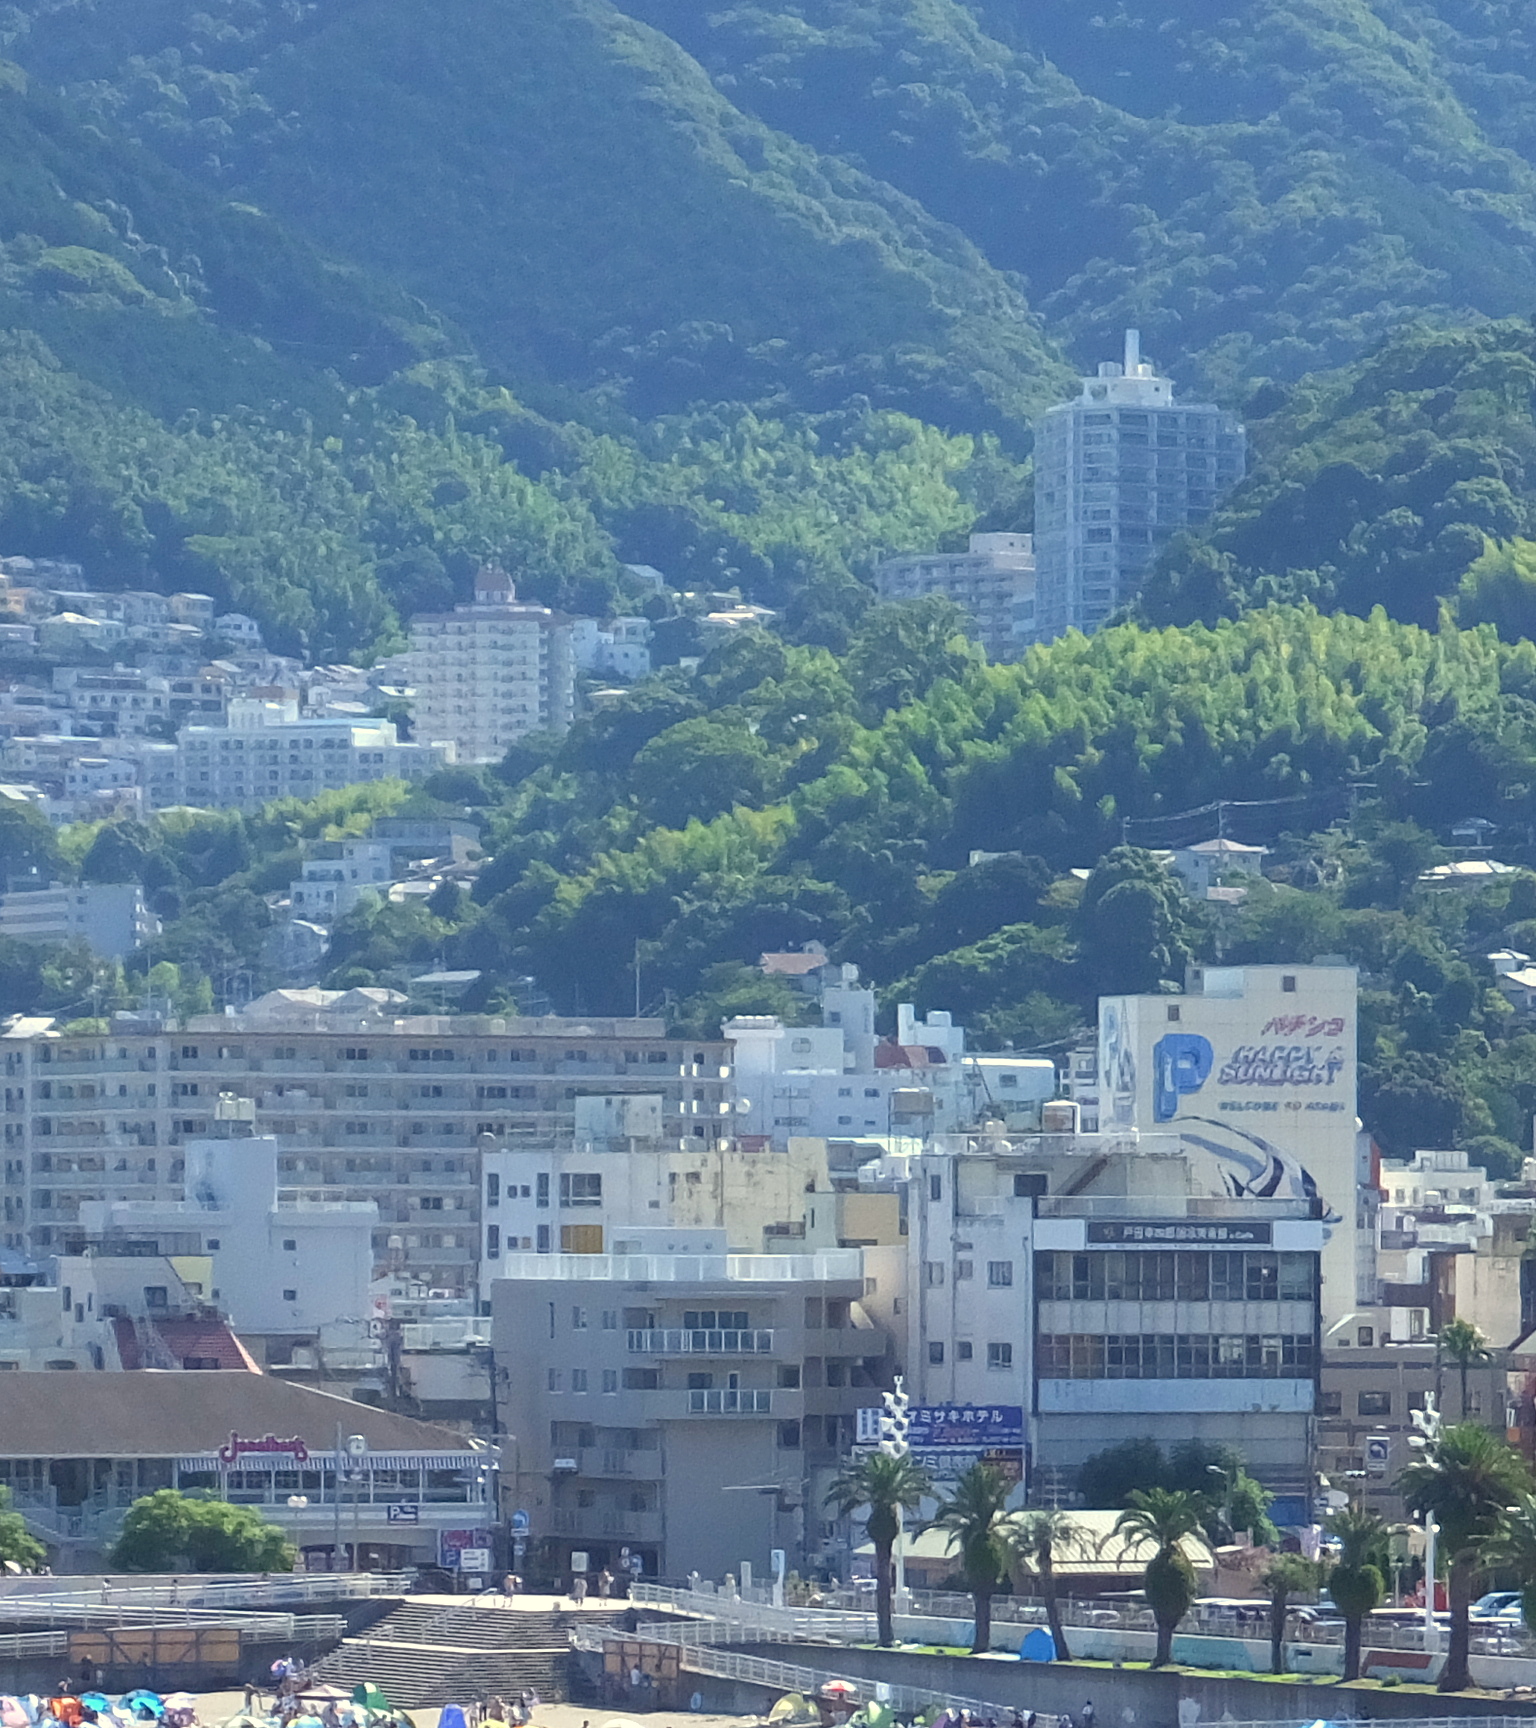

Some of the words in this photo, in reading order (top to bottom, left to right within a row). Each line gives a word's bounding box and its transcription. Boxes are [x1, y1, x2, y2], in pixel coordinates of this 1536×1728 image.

[1261, 1014, 1345, 1038] パチンコ
[1217, 1060, 1344, 1086] SUNLIGHT
